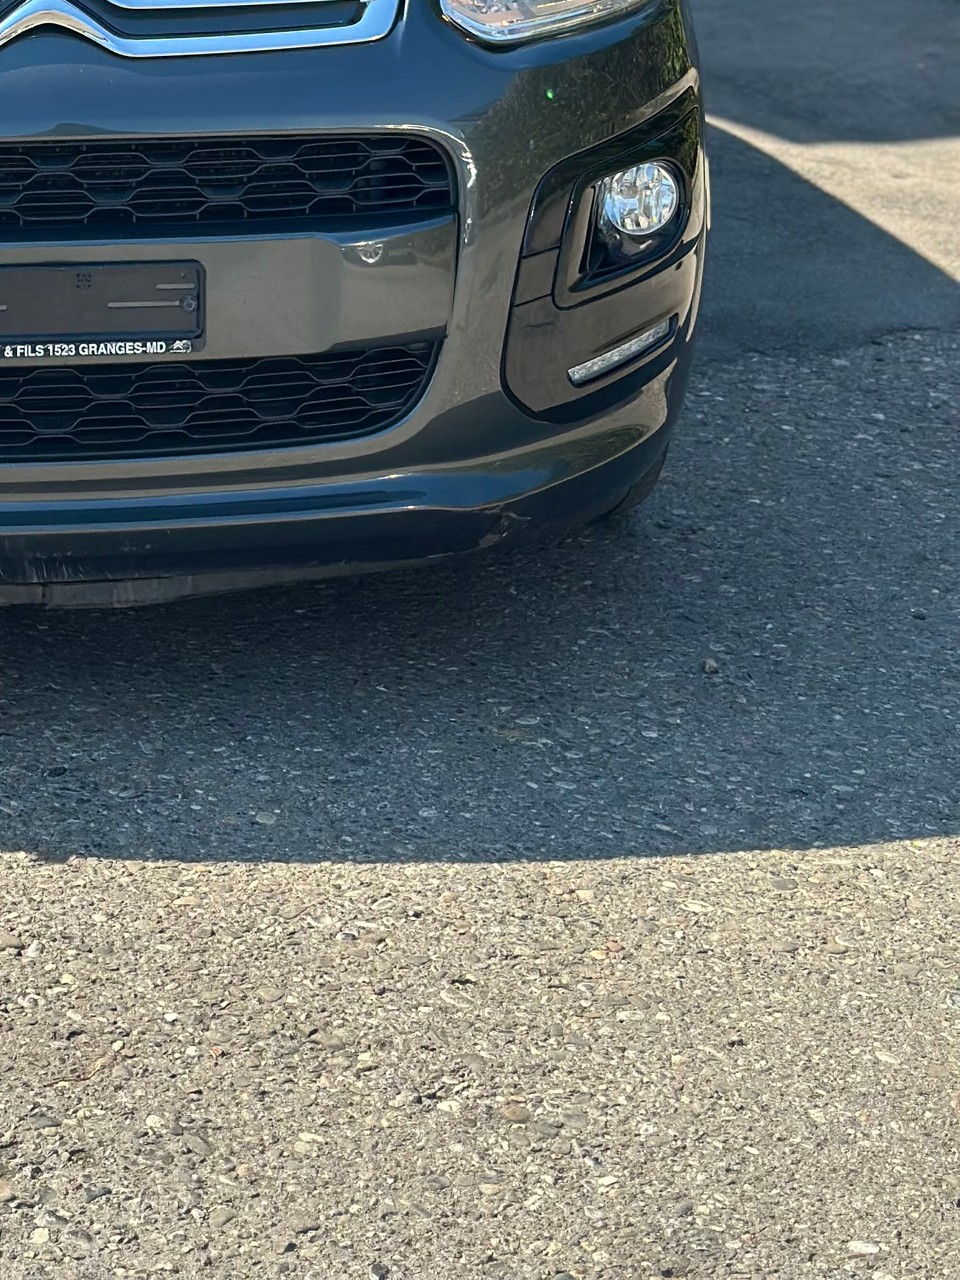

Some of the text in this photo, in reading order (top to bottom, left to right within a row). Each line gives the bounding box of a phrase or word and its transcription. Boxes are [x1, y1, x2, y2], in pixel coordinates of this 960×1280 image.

[4, 345, 14, 358] &
[16, 344, 45, 357] FILS
[48, 343, 76, 356] 1523
[78, 341, 167, 356] GRANGES-MD
